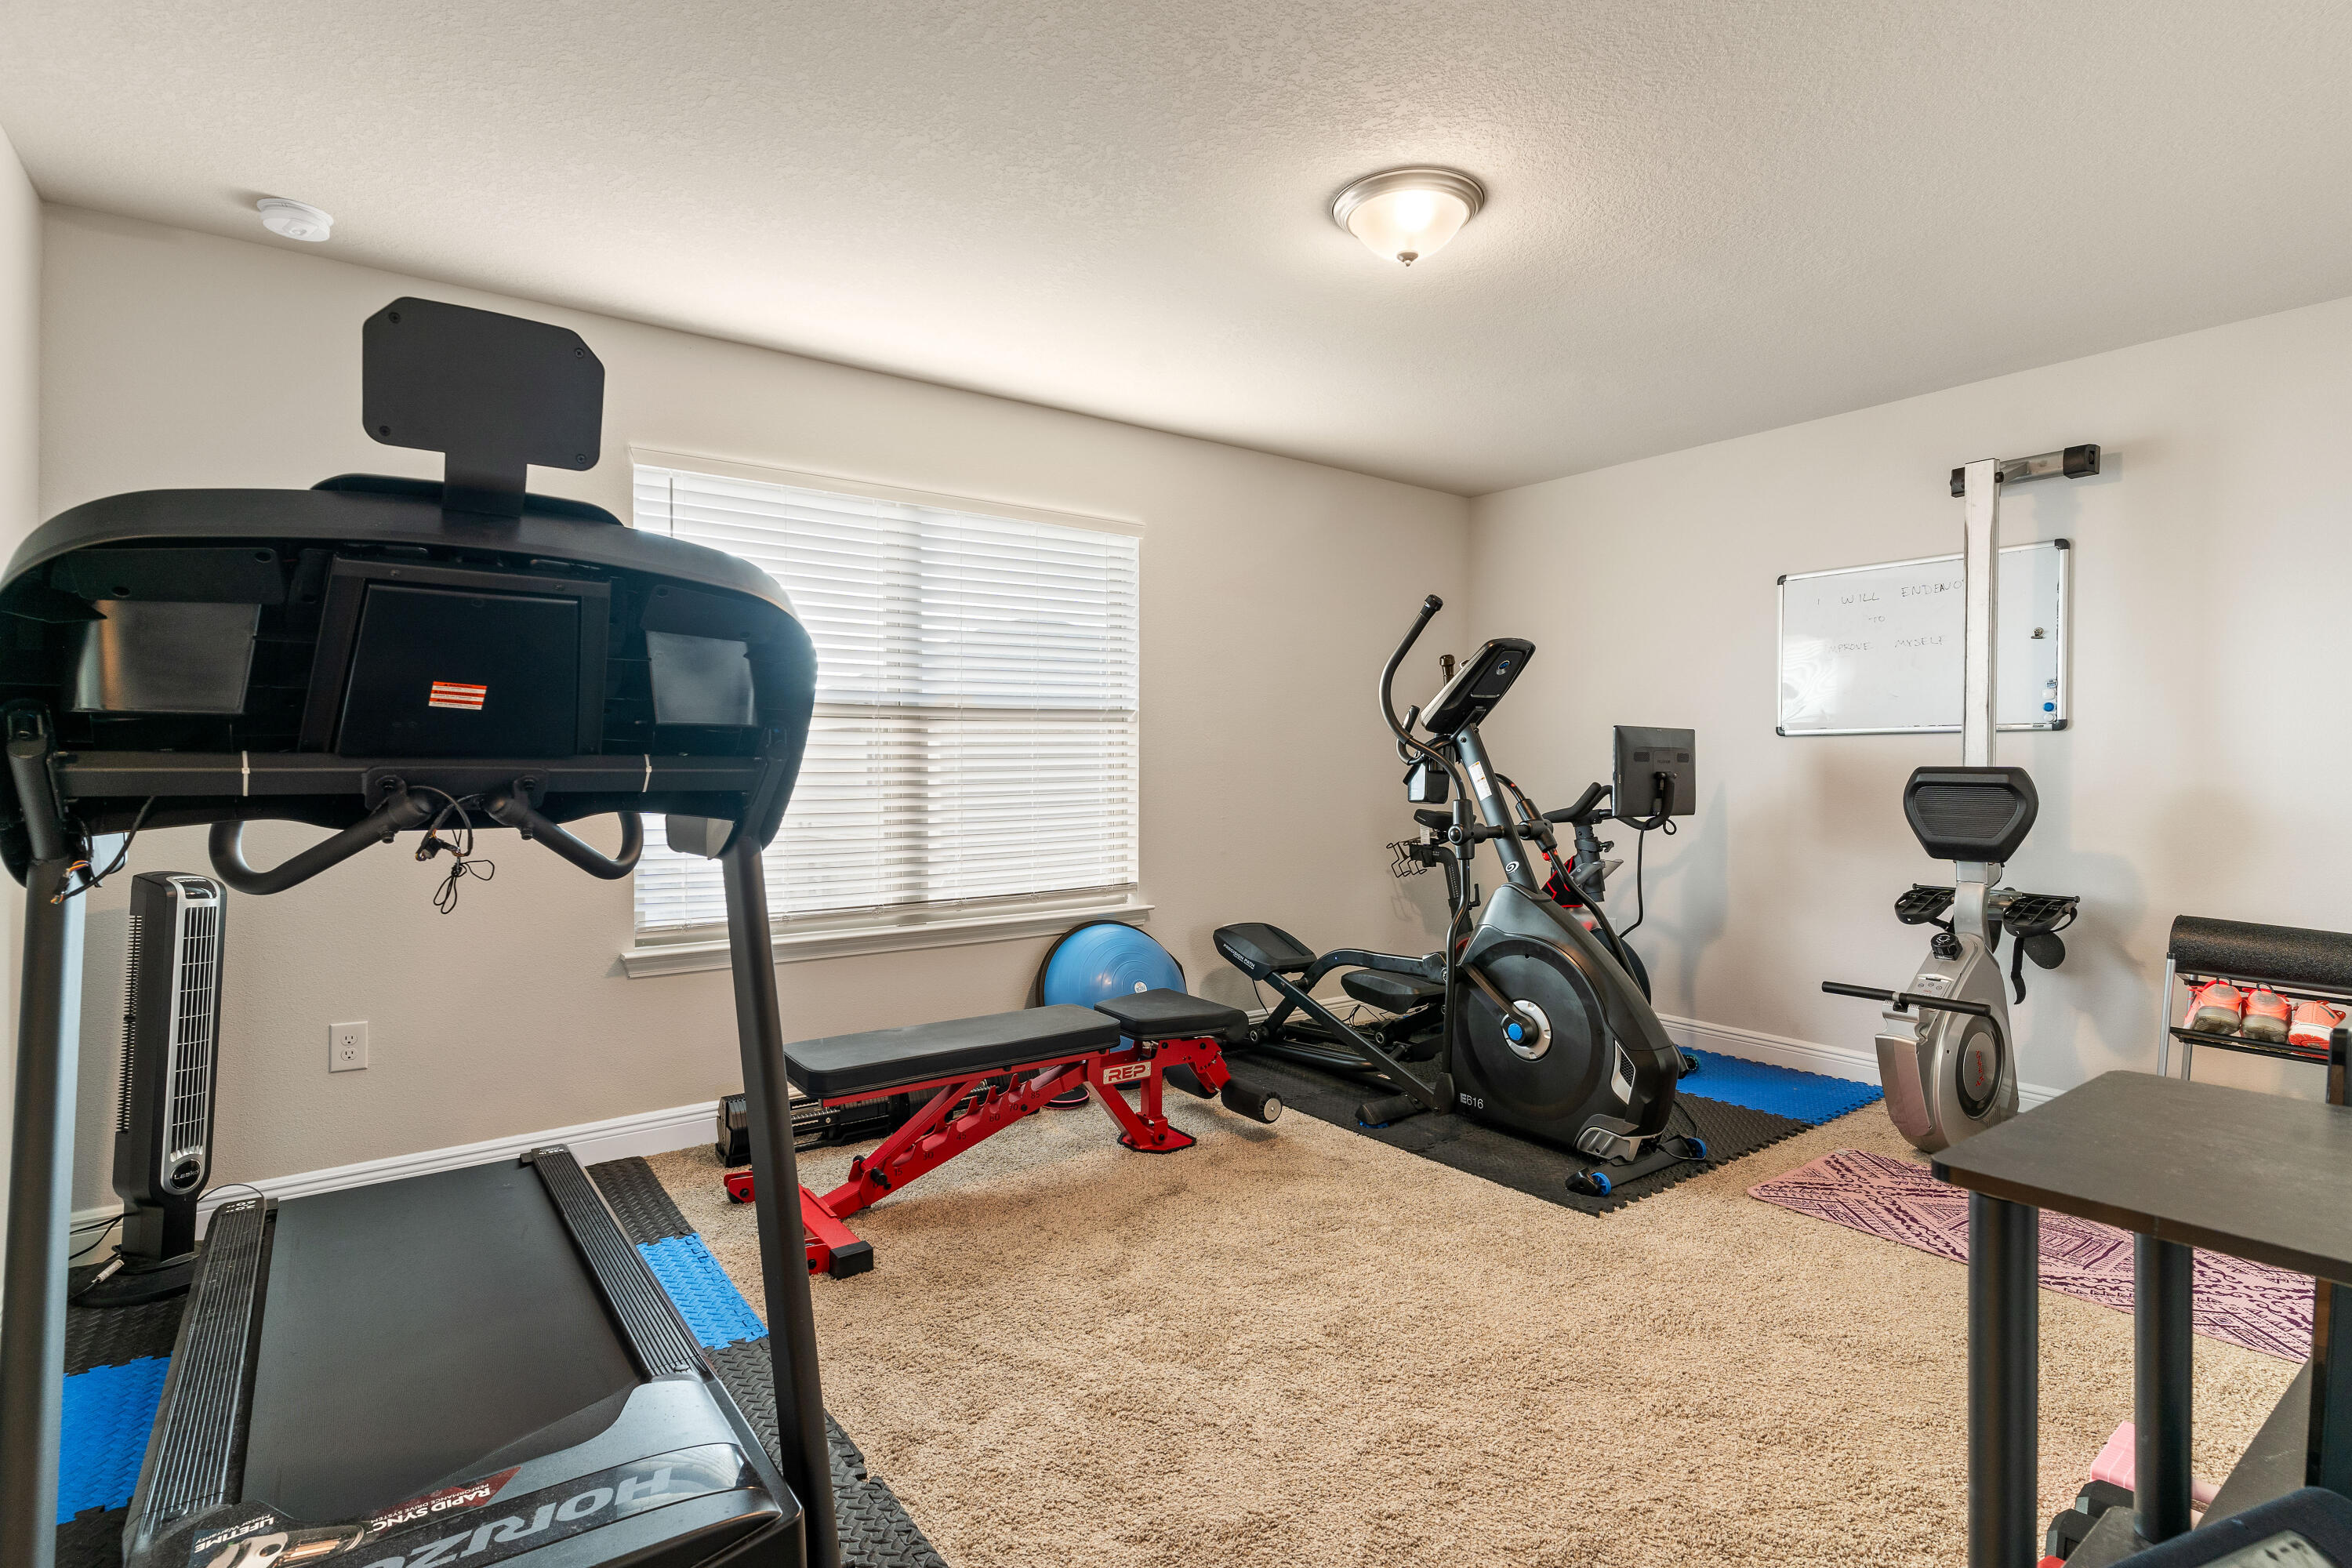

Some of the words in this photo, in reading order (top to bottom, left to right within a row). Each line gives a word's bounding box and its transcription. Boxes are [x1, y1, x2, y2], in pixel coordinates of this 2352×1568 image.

[1841, 592, 1880, 604] WILL
[1900, 579, 1965, 597] ENDEAVO
[1223, 943, 1244, 960] PRECISION
[1243, 955, 1255, 968] PATH
[1108, 1065, 1146, 1082] REP
[1030, 1091, 1040, 1099] 85
[1461, 1093, 1483, 1109] E616
[1009, 1103, 1018, 1112] 70
[989, 1113, 1000, 1123] 60
[956, 1132, 967, 1141] 45
[922, 1151, 935, 1160] 30
[174, 1170, 199, 1179] Lasko
[895, 1167, 903, 1177] 15
[431, 1483, 489, 1504] PERFORMANCE
[431, 1487, 490, 1512] RAPID
[405, 1503, 429, 1514] DRIVE
[241, 1514, 270, 1527] Motor
[361, 1467, 673, 1568] HORIZ
[371, 1509, 403, 1524] SYSTEM
[194, 1517, 275, 1553] LIFETIME
[195, 1525, 240, 1545] Warranty
